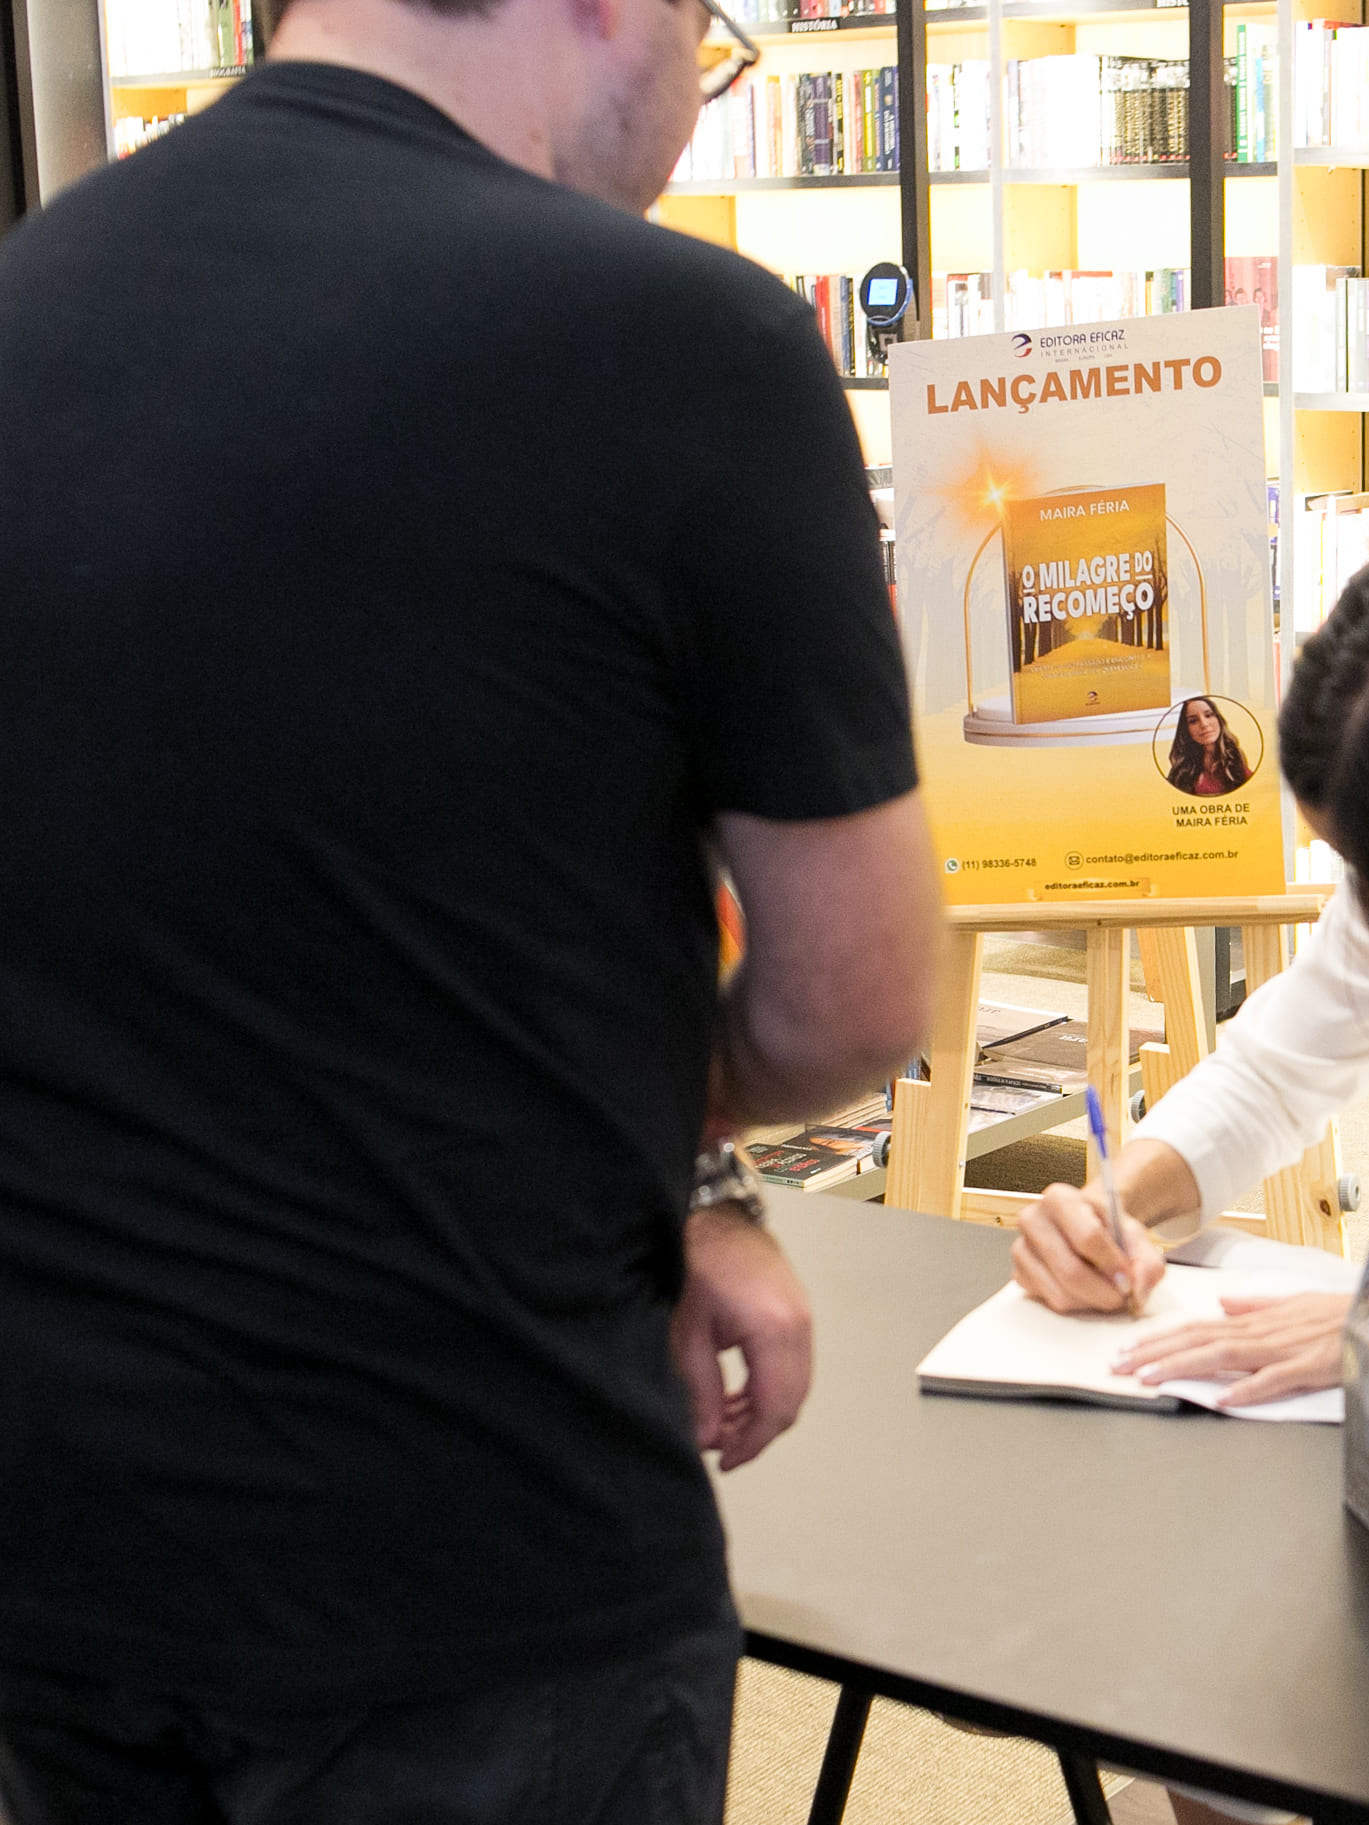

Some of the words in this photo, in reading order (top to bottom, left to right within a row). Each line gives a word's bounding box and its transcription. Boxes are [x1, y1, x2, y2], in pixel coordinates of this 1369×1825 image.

[1040, 334, 1086, 348] EDITORA
[1090, 330, 1125, 343] EFICAZ
[1041, 344, 1128, 357] INTERNACIONAL
[926, 356, 1222, 415] LANÇAMENTO
[1040, 504, 1085, 520] MAIRA
[1090, 499, 1129, 516] FÉRIA
[1022, 565, 1034, 588] O
[1039, 553, 1130, 591] MILAGRE
[1135, 551, 1152, 572] DO
[1023, 582, 1154, 623] RECOMEÇO
[1172, 804, 1197, 816] UMA
[1199, 803, 1232, 815] OBRA
[1235, 803, 1250, 814] DE
[1176, 817, 1212, 828] MAIRA
[1214, 814, 1248, 827] FÉRIA
[962, 860, 980, 870] (11)
[982, 858, 1037, 869] 98336-5748
[1086, 850, 1238, 865] contato@editoraeficaz.com.br
[1044, 879, 1140, 892] editoraeficaz.com.br
